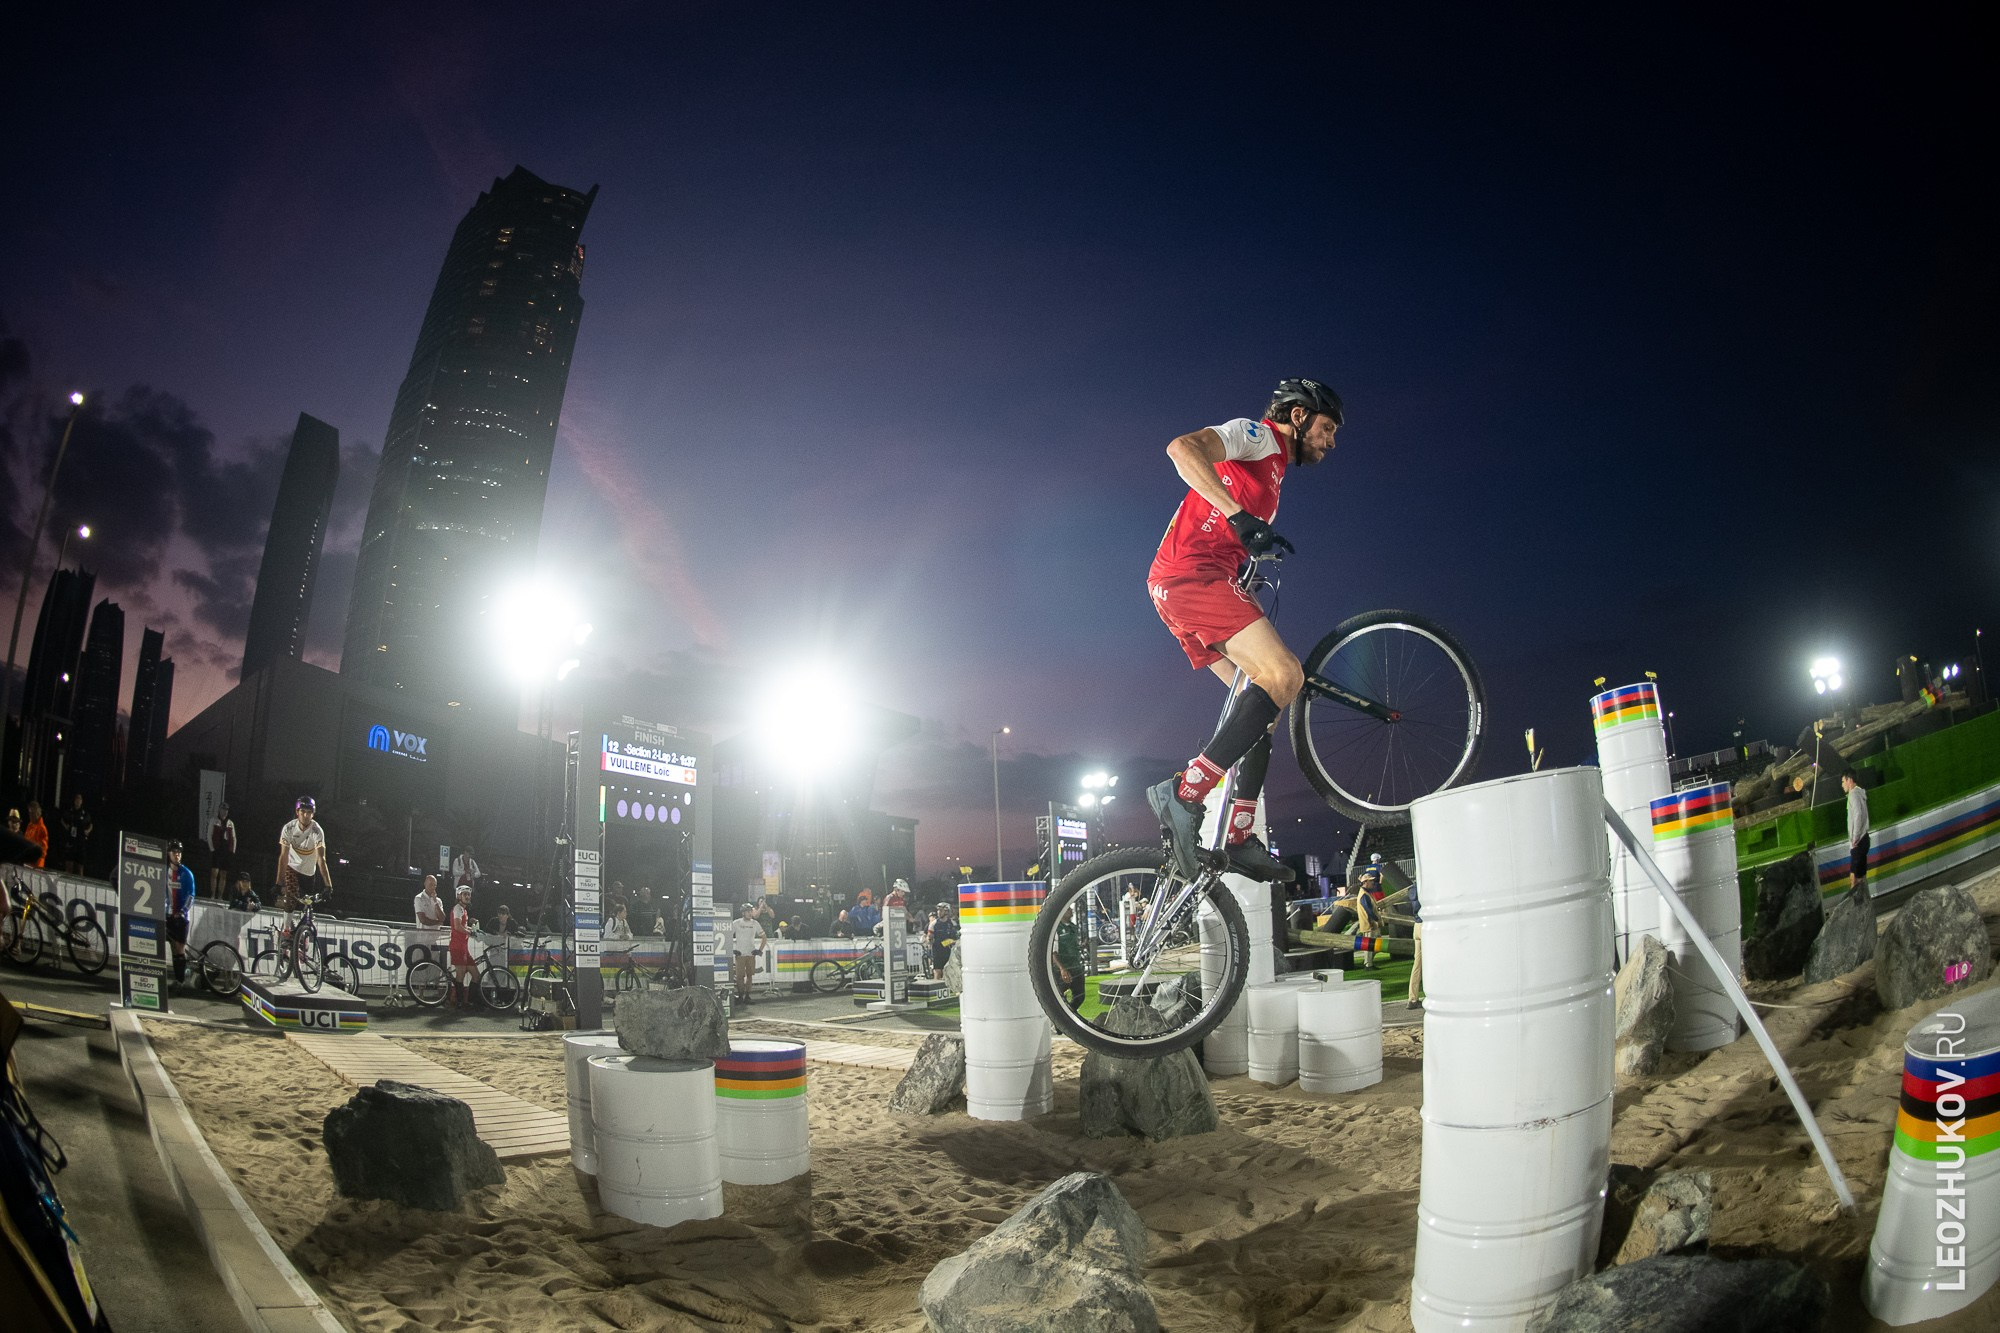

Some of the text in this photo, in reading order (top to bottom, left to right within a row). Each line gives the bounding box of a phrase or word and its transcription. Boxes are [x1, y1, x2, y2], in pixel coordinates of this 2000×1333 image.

[393, 730, 427, 755] VOX
[607, 740, 619, 753] 12
[634, 730, 665, 746] FINISH
[610, 756, 652, 774] VUILLEME
[581, 851, 598, 861] UCI
[124, 861, 163, 881] START
[133, 879, 153, 915] 2
[582, 944, 598, 953] UCI
[714, 932, 728, 956] 2
[895, 930, 903, 949] 3
[700, 945, 712, 953] UCI
[133, 980, 156, 989] TISSOT
[300, 1010, 337, 1028] UCI
